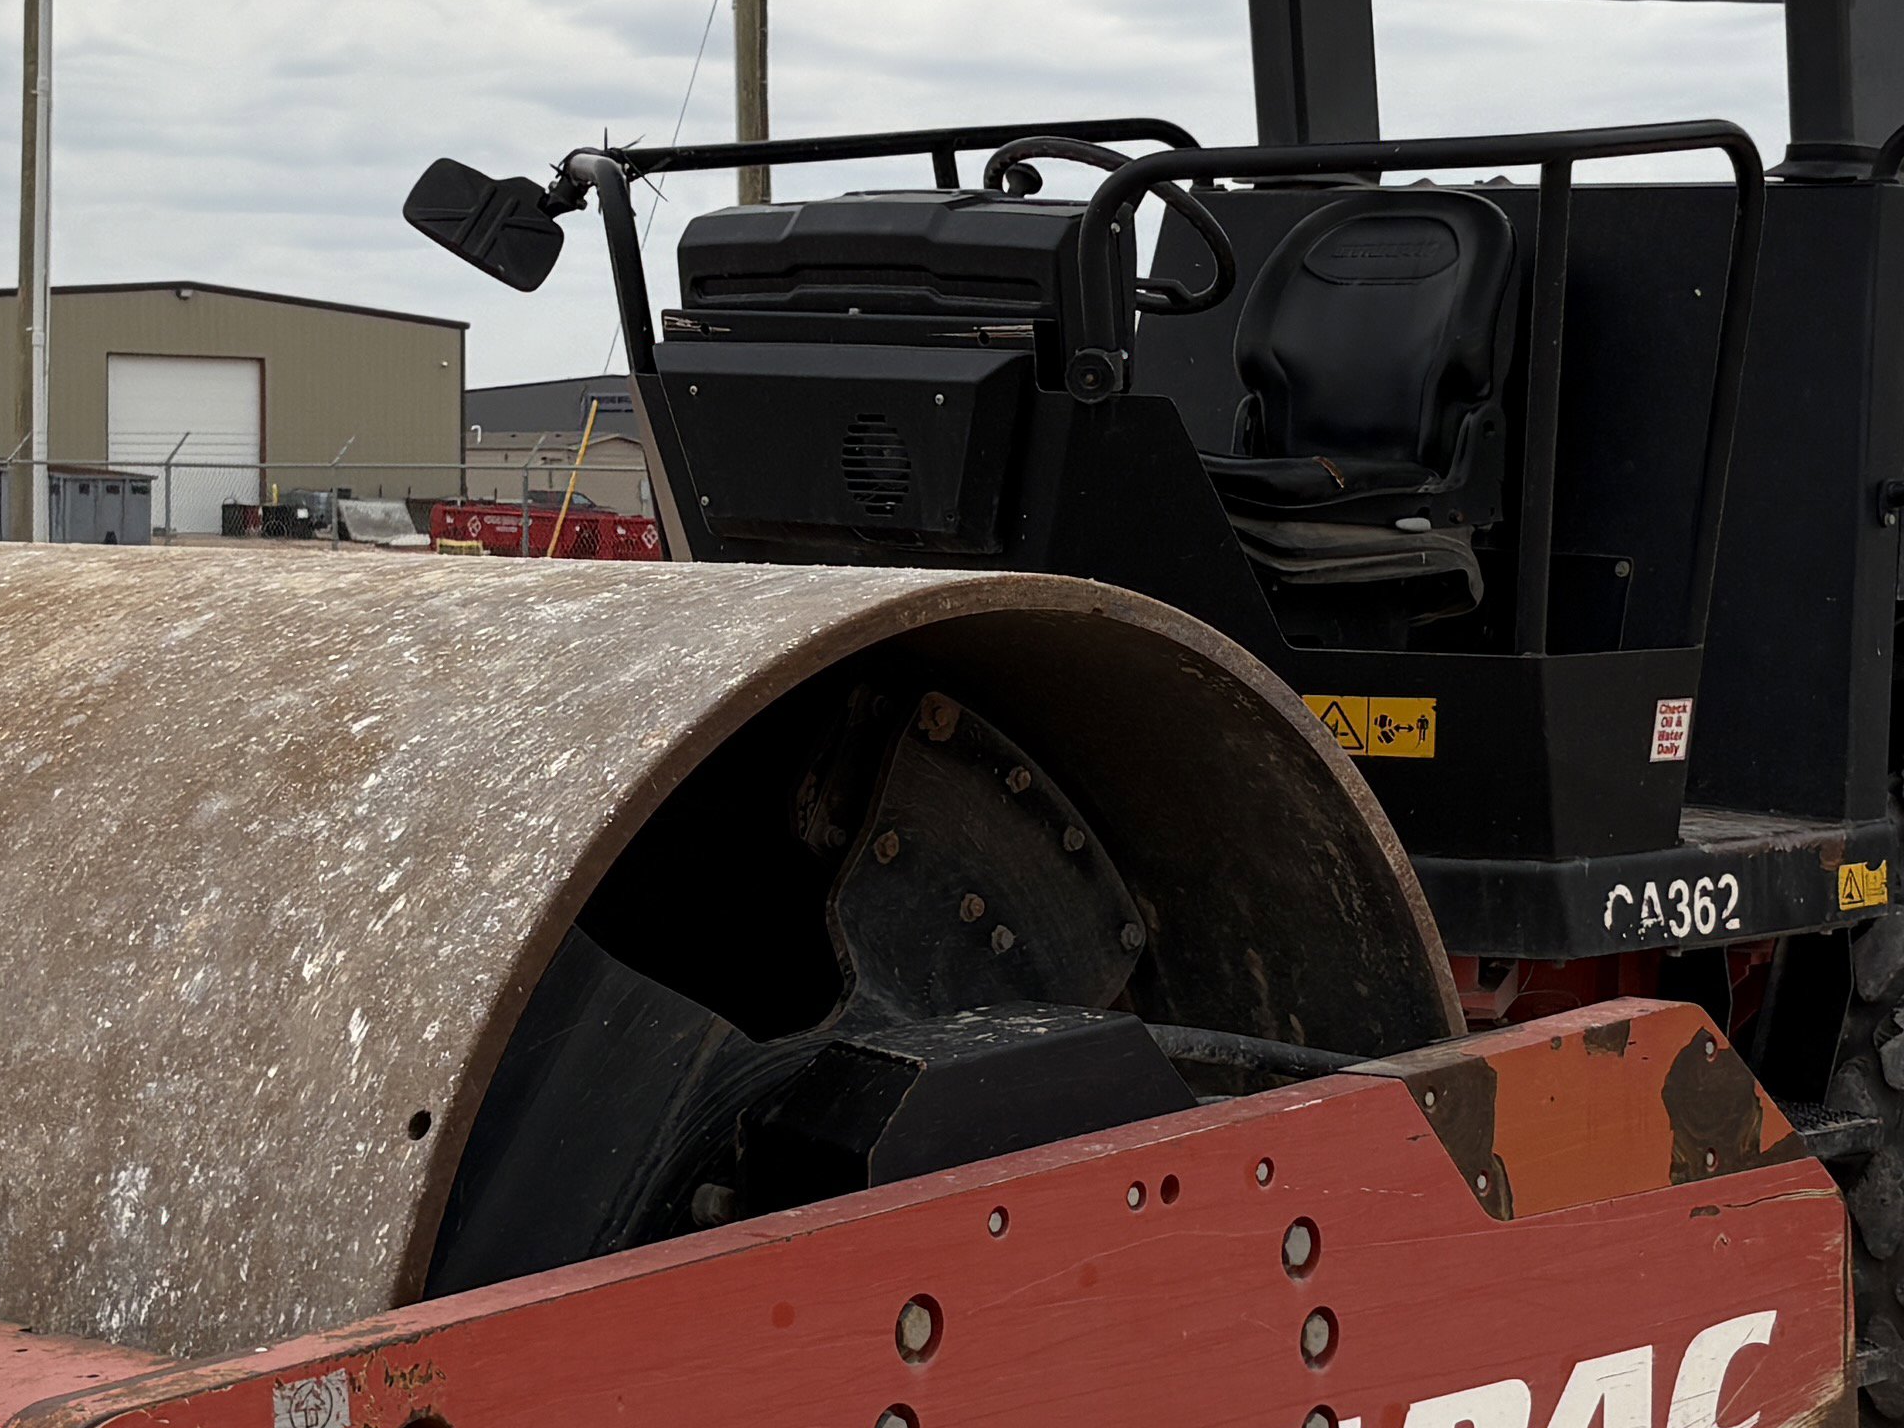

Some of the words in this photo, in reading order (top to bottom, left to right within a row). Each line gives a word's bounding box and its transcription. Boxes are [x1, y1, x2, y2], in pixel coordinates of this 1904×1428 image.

[1659, 702, 1687, 714] Check
[1657, 742, 1679, 756] Daily
[1603, 873, 1741, 940] CA362
